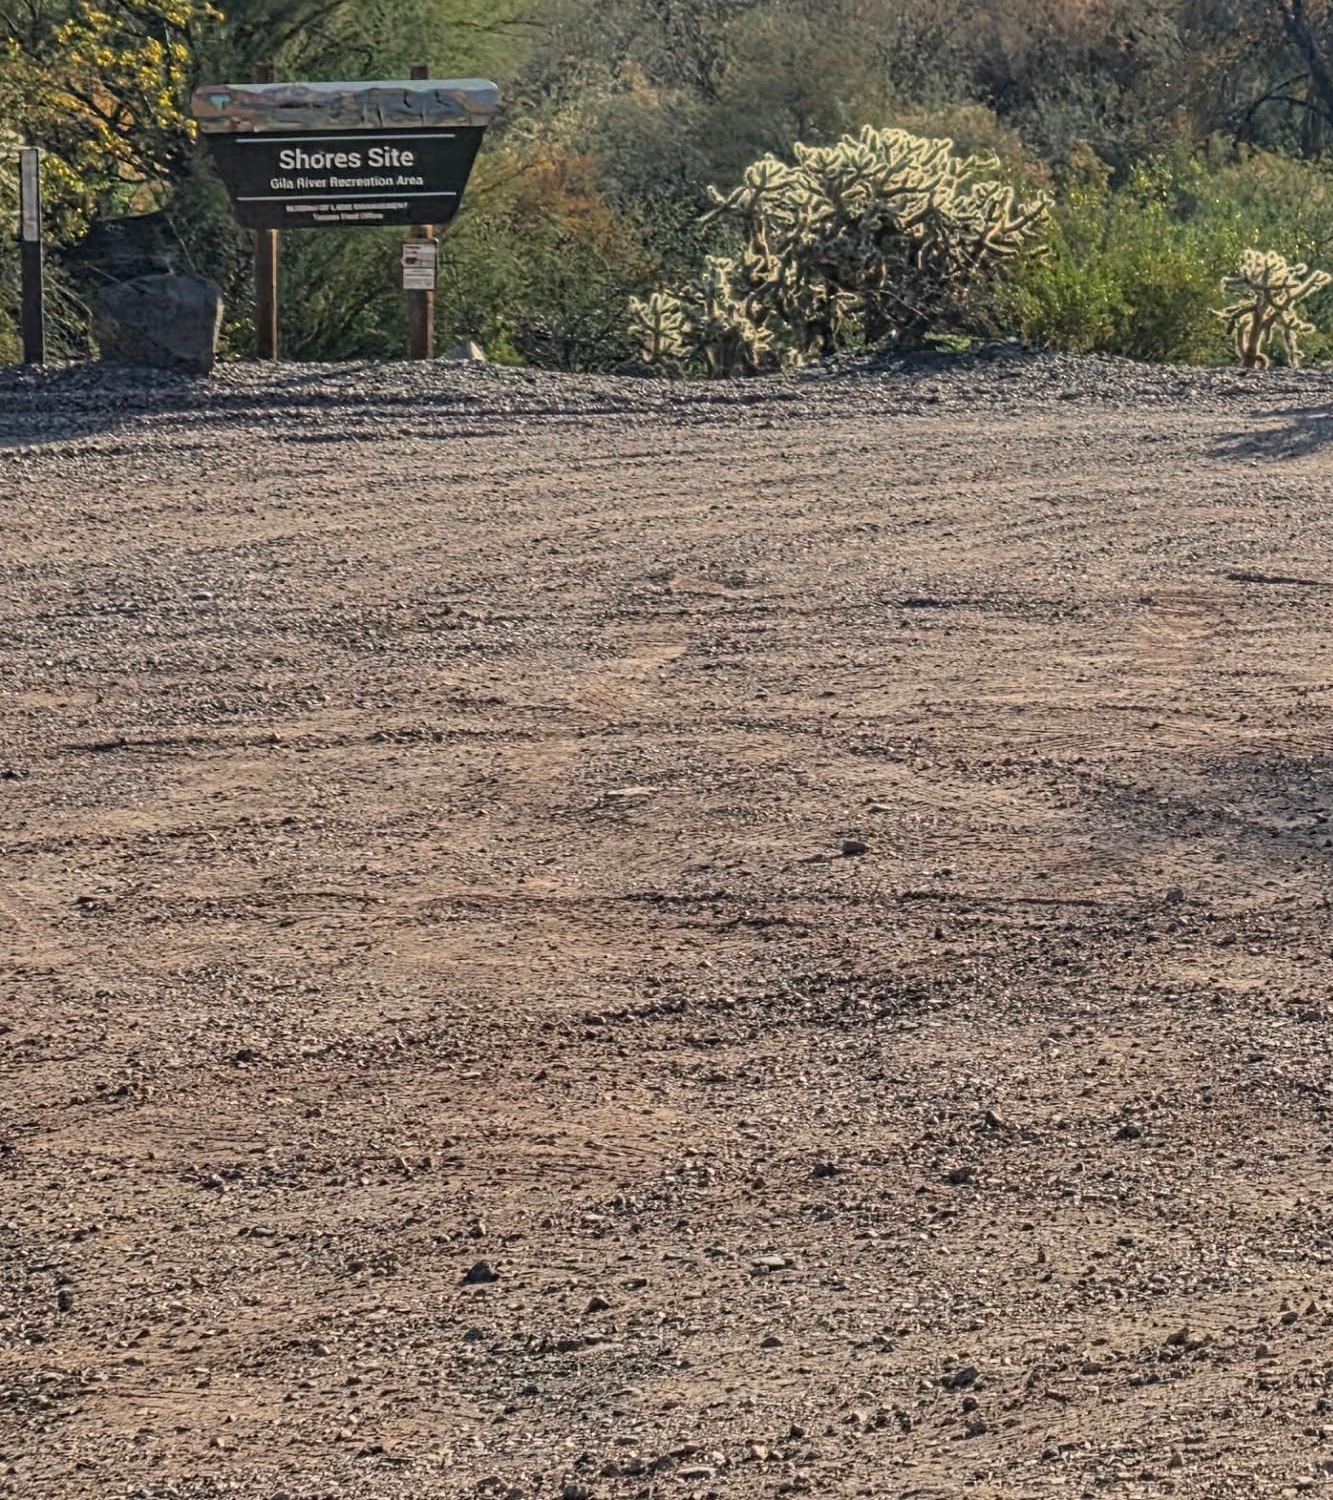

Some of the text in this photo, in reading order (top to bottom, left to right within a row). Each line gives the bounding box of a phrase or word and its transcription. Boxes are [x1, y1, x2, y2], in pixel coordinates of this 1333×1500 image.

[279, 146, 414, 169] Shores Site
[270, 174, 424, 189] Gila River Recreation Area
